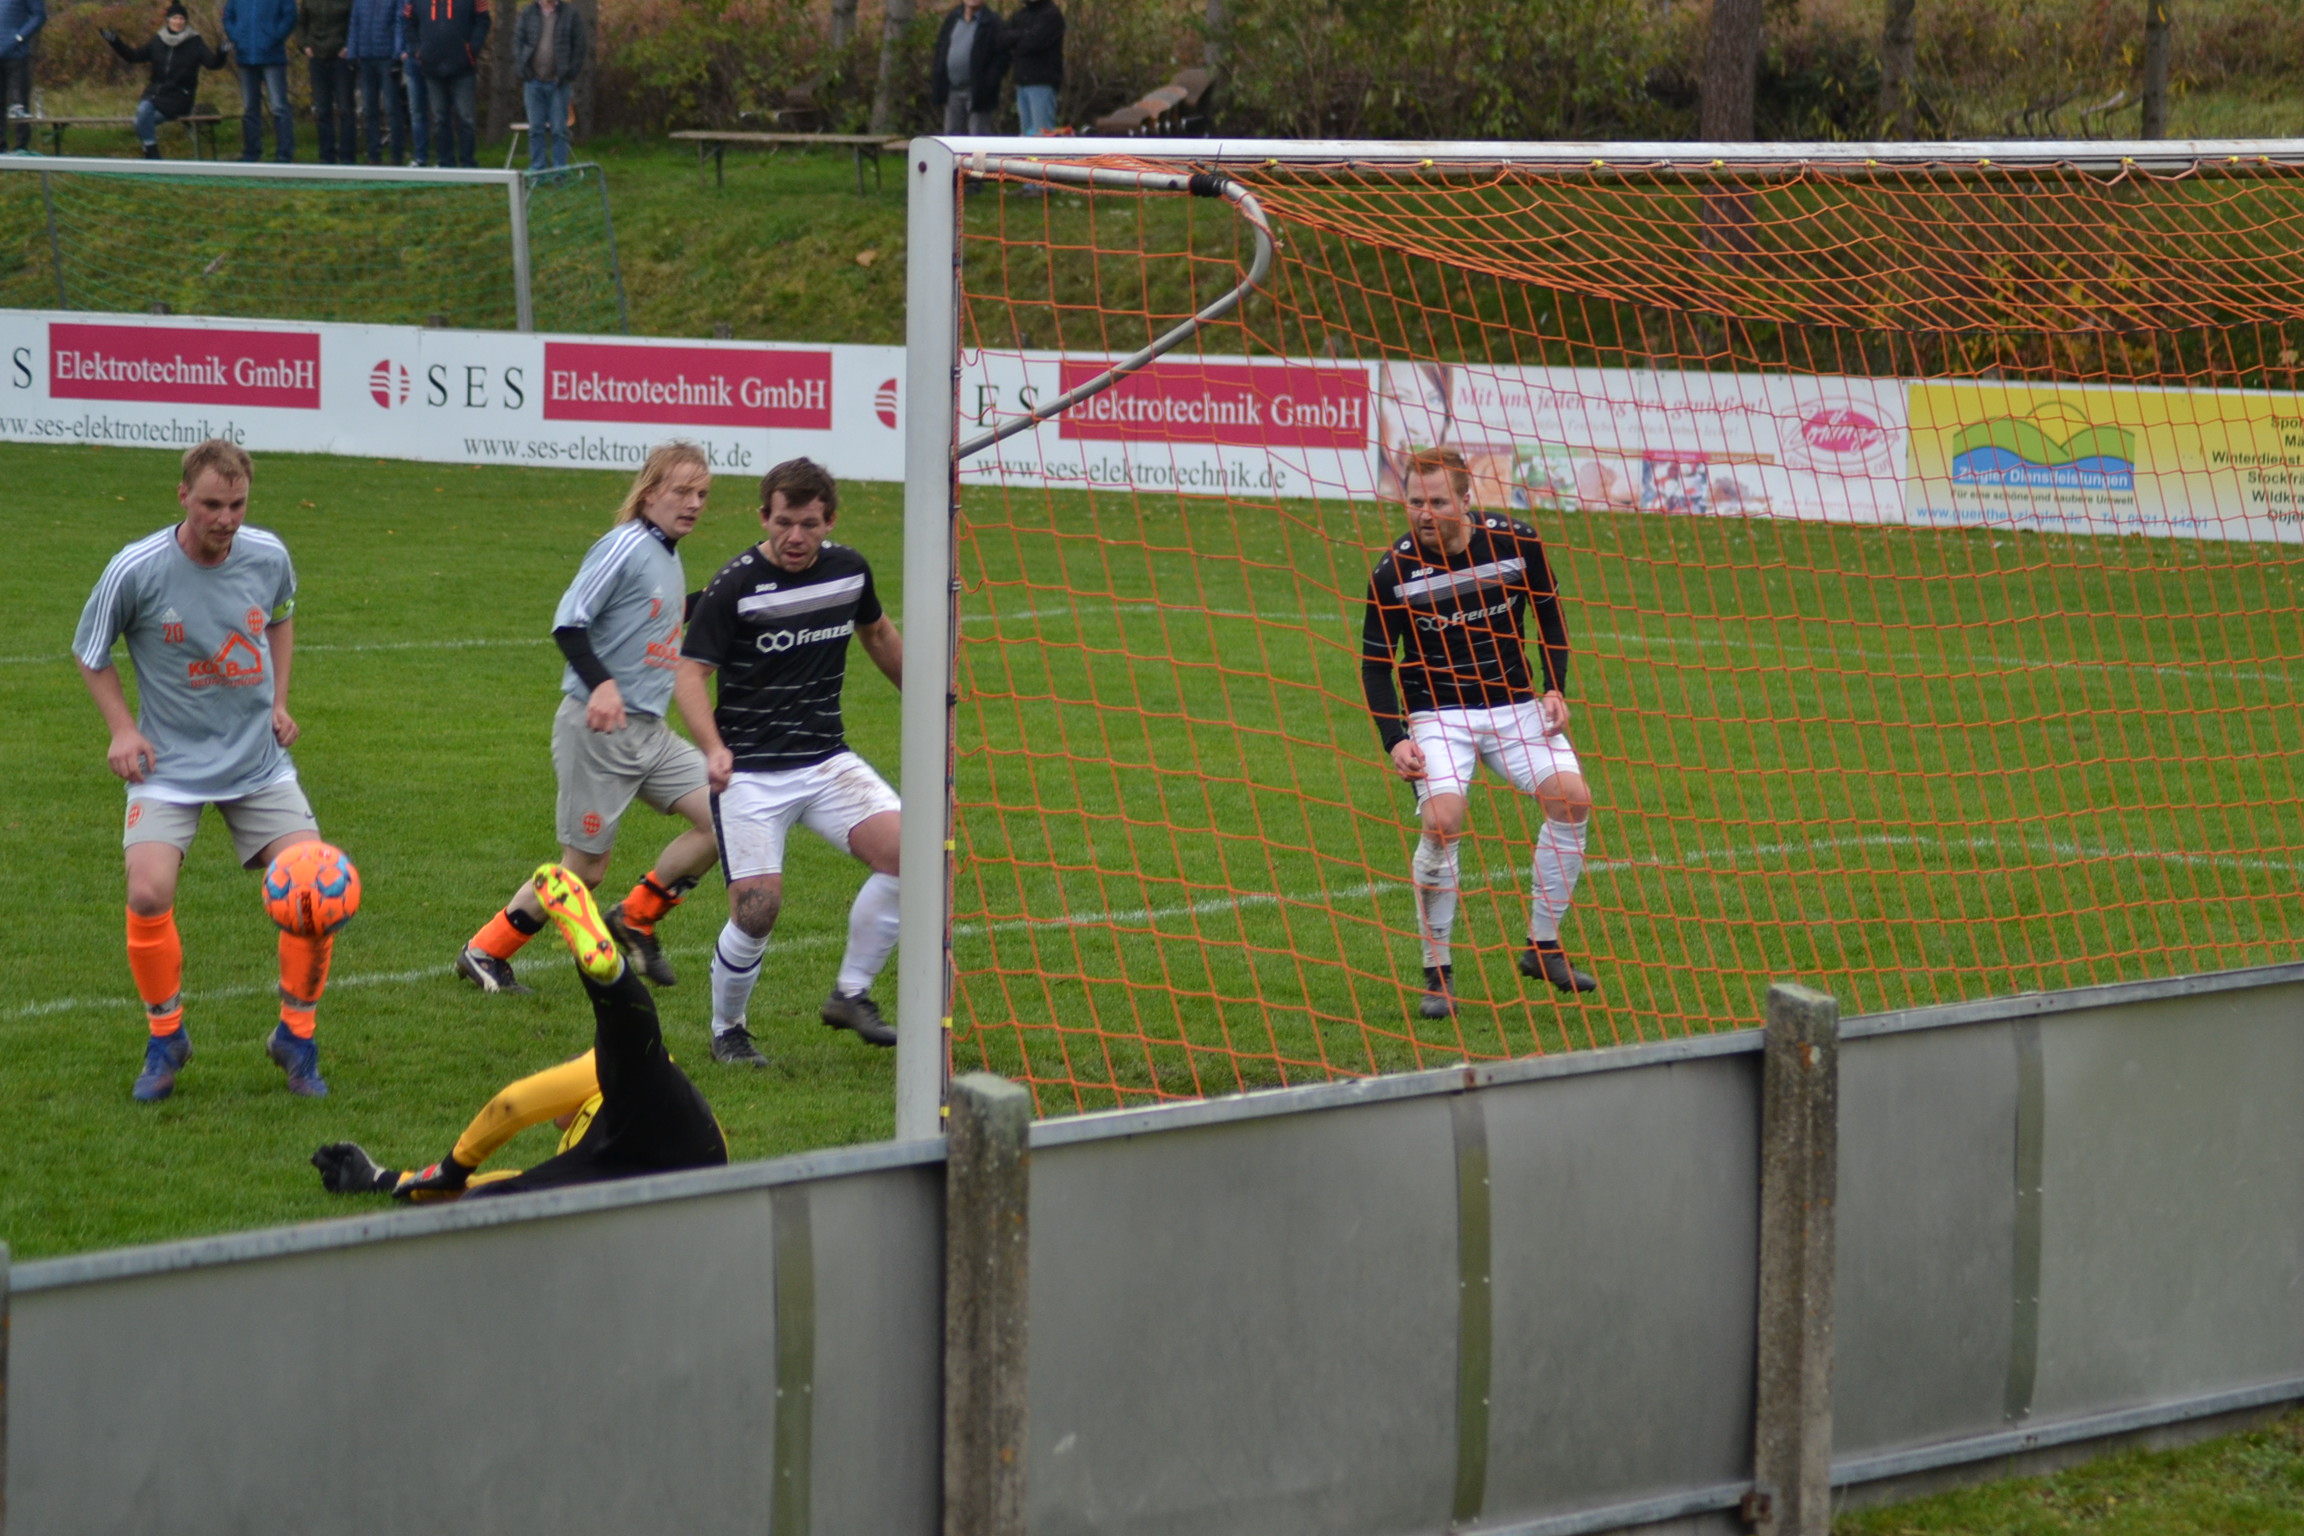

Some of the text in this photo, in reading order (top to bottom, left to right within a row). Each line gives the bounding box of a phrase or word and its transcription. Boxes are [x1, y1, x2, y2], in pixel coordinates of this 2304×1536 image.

[12, 346, 316, 390] S Elektrotechnik GmbH
[427, 364, 827, 411] SES Elektrotechnik GmbH
[975, 383, 1363, 431] ES Elektrotechnik GmbH
[0, 414, 246, 446] w.ses-elektrotechnikde
[464, 435, 752, 468] www.ses-elektrotk.de
[2212, 450, 2301, 466] Winterdienst
[976, 455, 1287, 490] www.ses-elektrotechnik.de
[2009, 468, 2129, 489] Dienstleistungen
[163, 622, 185, 644] 20
